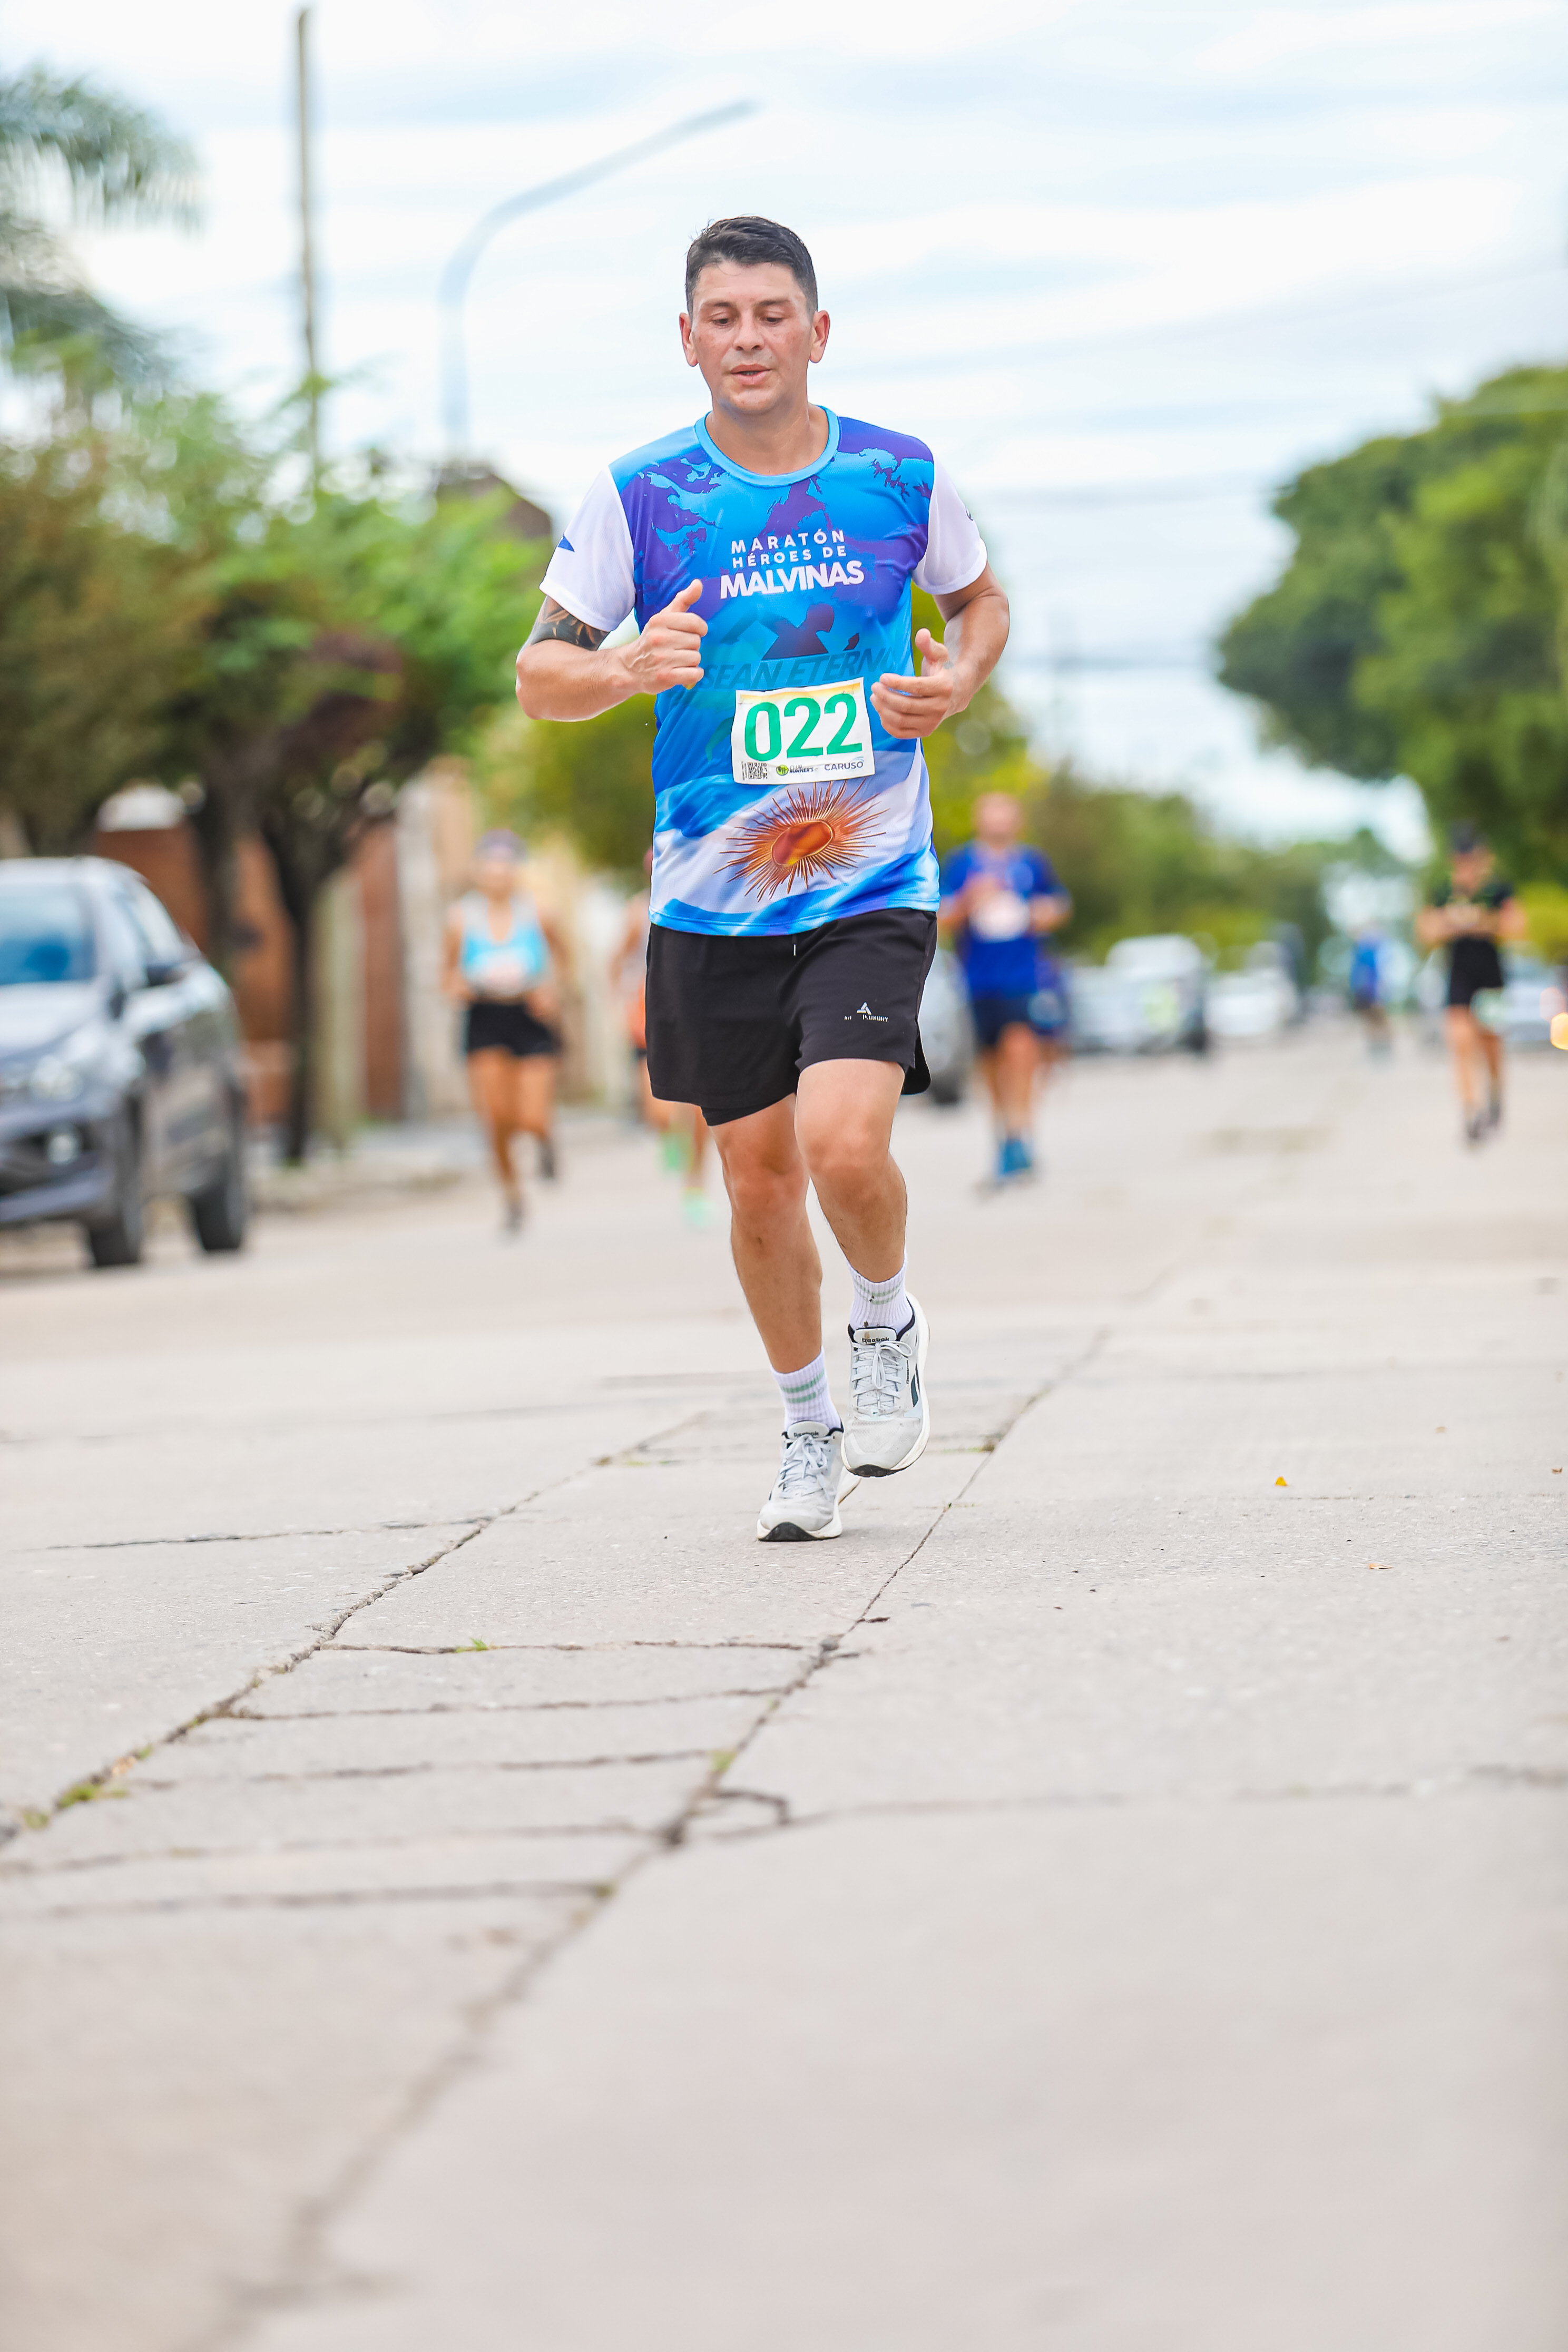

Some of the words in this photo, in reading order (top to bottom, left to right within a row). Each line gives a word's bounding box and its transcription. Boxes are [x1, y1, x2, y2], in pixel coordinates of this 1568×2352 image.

[731, 528, 845, 554] MARATÓN
[732, 548, 812, 569] HÉROES
[822, 545, 847, 558] DE
[720, 560, 865, 599] MALVINAS
[703, 661, 782, 690] SEAN
[744, 693, 863, 762] 022
[824, 761, 864, 771] CARUSO
